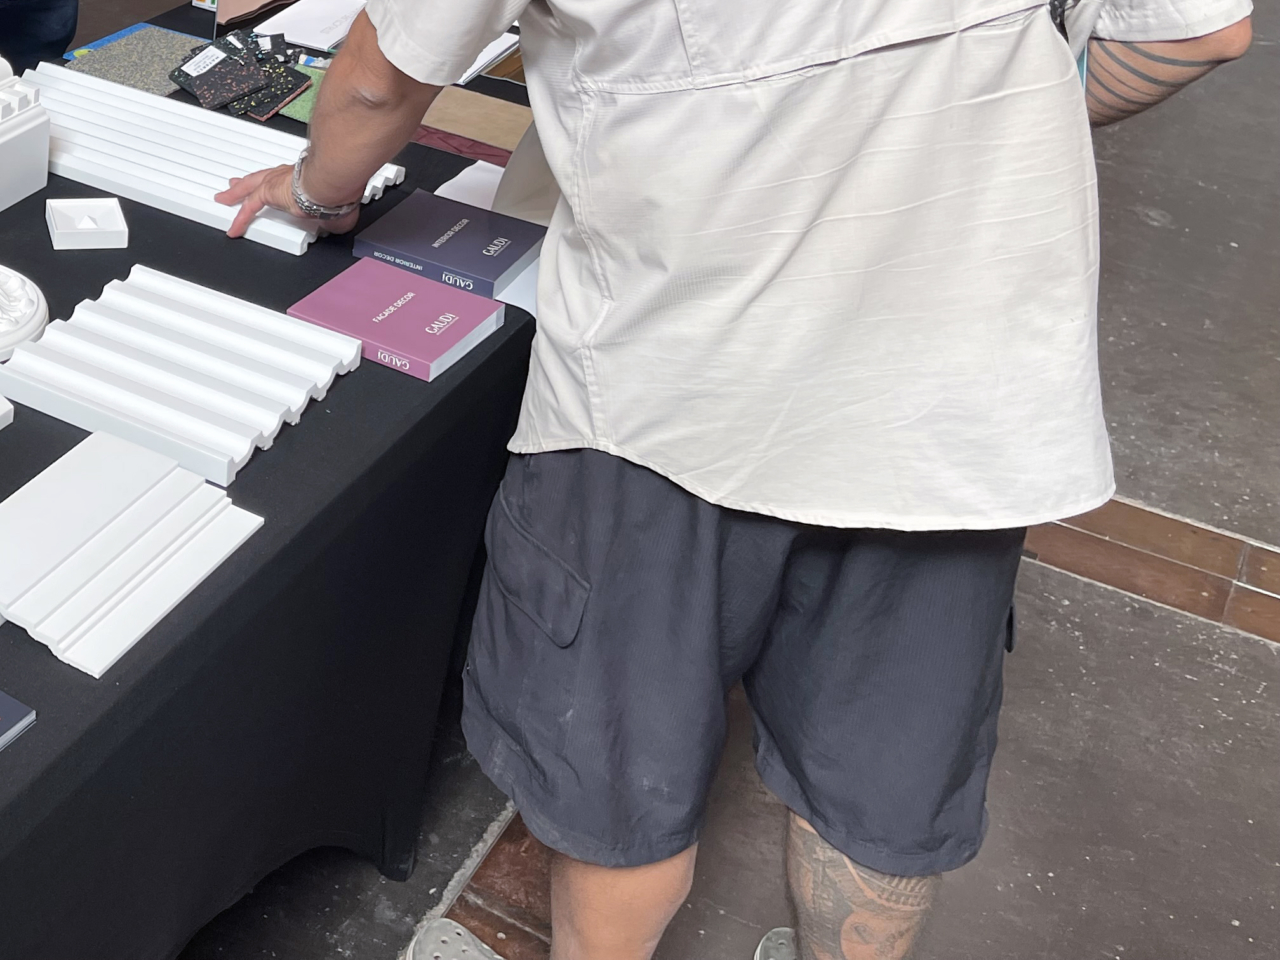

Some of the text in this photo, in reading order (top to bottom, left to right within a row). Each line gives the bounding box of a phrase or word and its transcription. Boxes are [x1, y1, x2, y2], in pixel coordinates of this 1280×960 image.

[431, 218, 471, 248] INTERIOR DECOR
[373, 251, 423, 271] INTERIOR DECOR
[372, 291, 417, 323] FACADE DECOR
